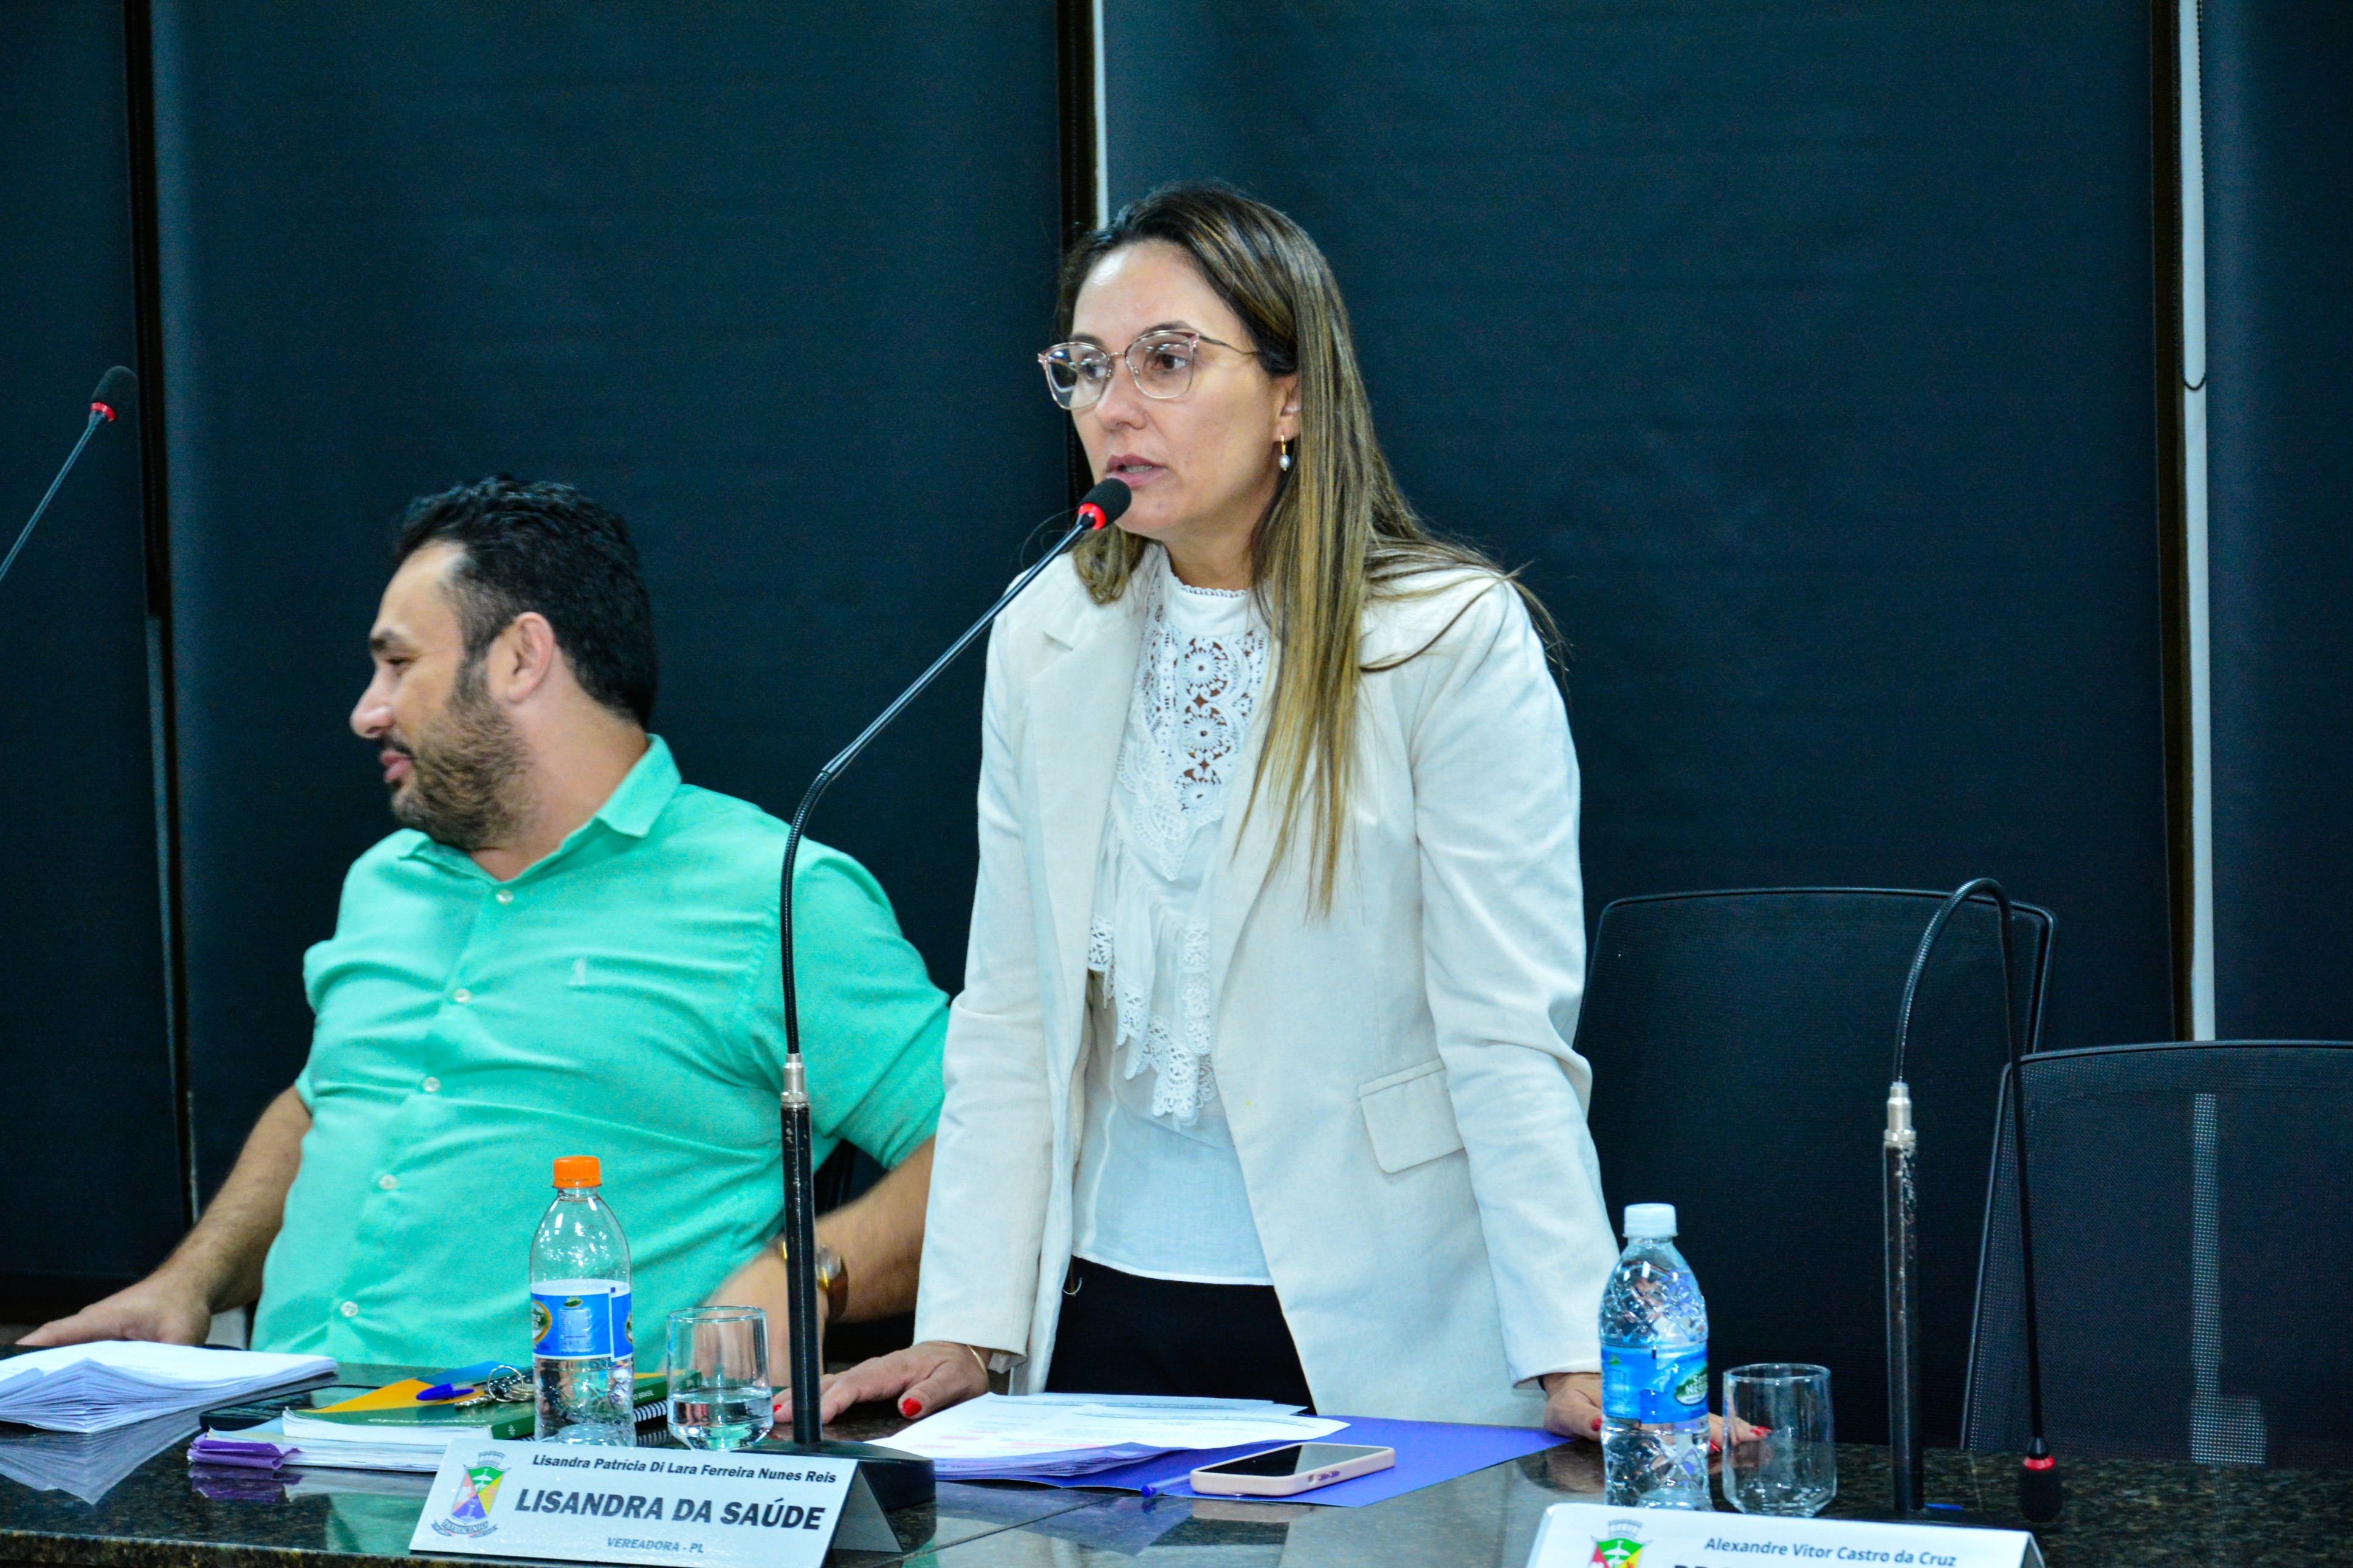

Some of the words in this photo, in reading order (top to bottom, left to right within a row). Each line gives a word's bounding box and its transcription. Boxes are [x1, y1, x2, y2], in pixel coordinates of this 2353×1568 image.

[639, 1390, 654, 1399] BRASIL
[532, 1454, 591, 1468] Lisandra
[594, 1459, 647, 1471] Patrícia
[650, 1461, 665, 1473] Di
[667, 1462, 698, 1474] Lara
[701, 1465, 755, 1478] Ferreira
[758, 1468, 802, 1481] Nunes
[805, 1471, 837, 1484] Reis
[515, 1488, 664, 1520] LISANDRA
[672, 1498, 712, 1523] DA
[720, 1498, 826, 1530] SAÚDE
[607, 1537, 679, 1552] VEREADORA
[689, 1542, 704, 1553] PL
[1705, 1538, 1788, 1555] Alexandre
[1793, 1543, 1832, 1559] Vitor
[1837, 1547, 1889, 1563] Castro
[1894, 1551, 1914, 1564] da
[1919, 1552, 1957, 1567] Cruz
